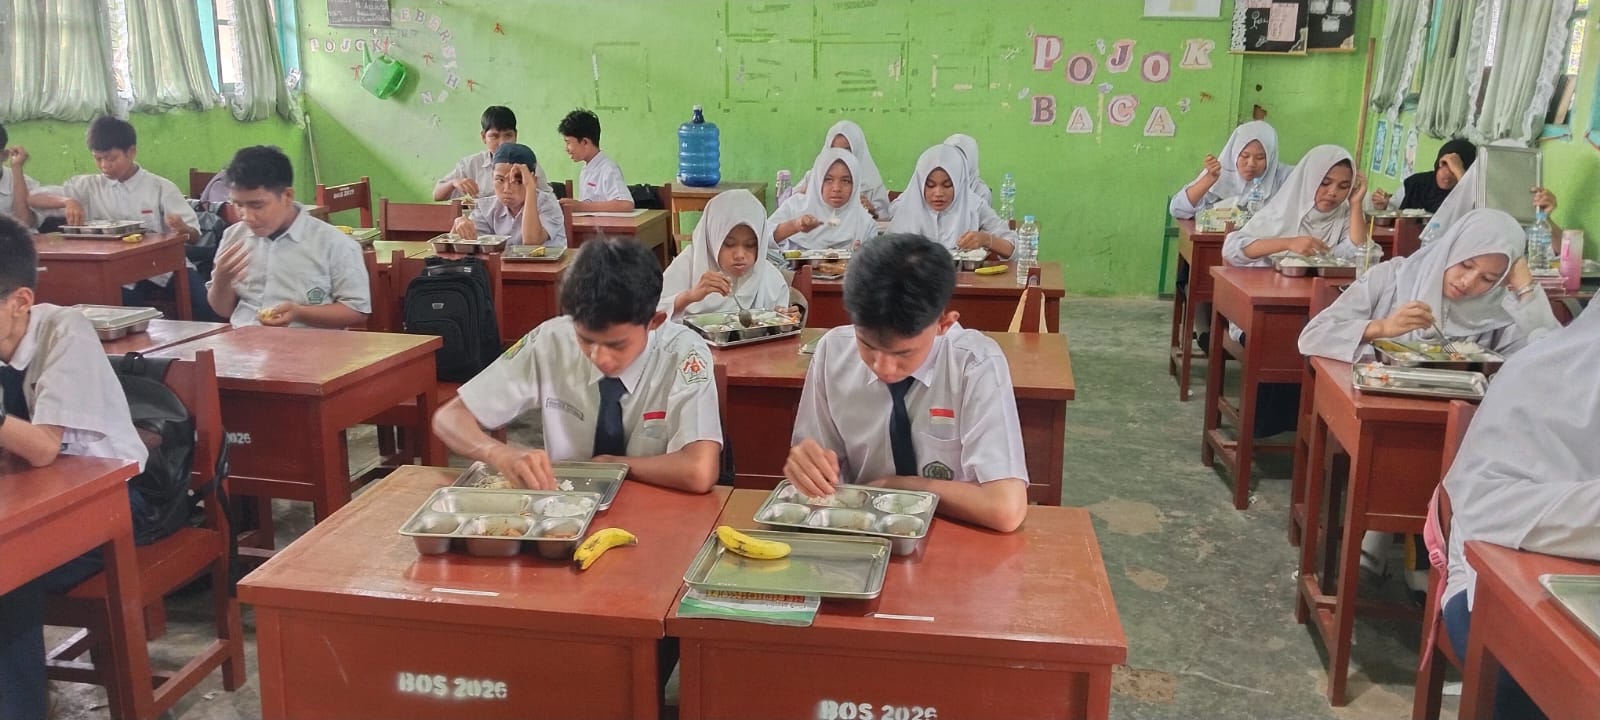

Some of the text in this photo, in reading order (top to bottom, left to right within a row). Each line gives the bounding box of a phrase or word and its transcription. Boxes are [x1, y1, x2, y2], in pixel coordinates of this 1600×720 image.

[1034, 35, 1213, 84] POJOK
[1032, 96, 1175, 136] BACA
[398, 672, 507, 699] BOS 2026
[819, 700, 937, 720] BOS 2026
